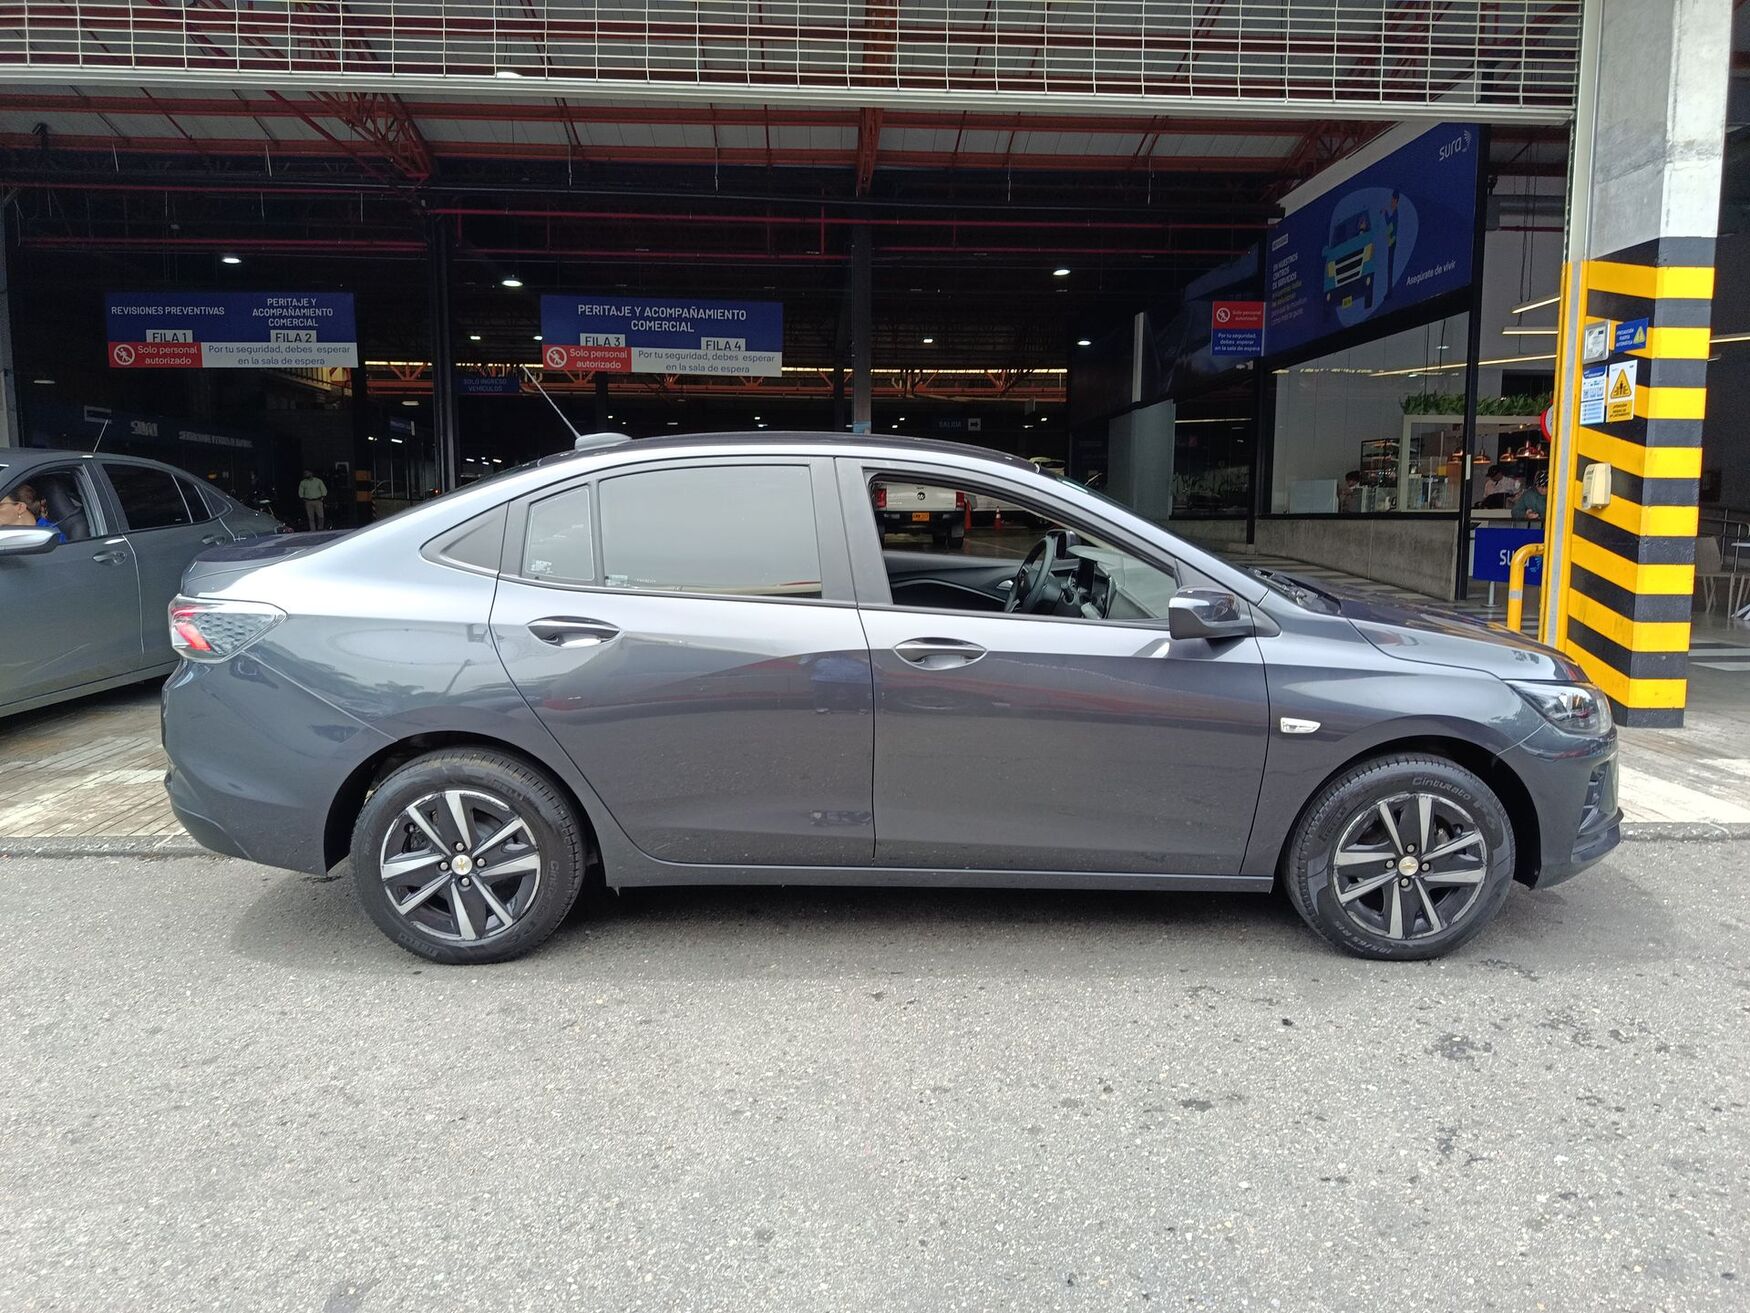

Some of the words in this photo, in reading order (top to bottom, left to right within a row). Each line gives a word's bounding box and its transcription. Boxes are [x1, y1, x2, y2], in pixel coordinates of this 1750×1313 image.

[1439, 136, 1462, 161] sura
[267, 298, 310, 307] PERITAJE
[310, 298, 317, 306] Y
[111, 306, 164, 315] REVISIONES
[165, 306, 225, 315] PREVENTIVAS
[252, 306, 333, 317] ACOMPAÑAMIENTO
[578, 305, 632, 317] PERITAJE
[633, 306, 641, 317] Y
[644, 306, 747, 321] ACOMPAÑAMIENTO
[268, 318, 318, 327] COMERCIAL
[631, 320, 695, 333] COMERCIAL
[152, 332, 179, 343] FILA
[182, 332, 187, 343] 1
[275, 332, 302, 343] FILA
[304, 332, 312, 343] 2
[585, 336, 612, 347] FILA
[613, 337, 621, 347] 3
[137, 345, 158, 354] Solo
[159, 345, 198, 356] personal
[209, 345, 224, 353] Por
[225, 345, 235, 353] tu
[285, 345, 313, 353] debes
[316, 346, 351, 355] esperar
[706, 340, 732, 351] FILA
[734, 341, 741, 352] 4
[145, 356, 192, 365] autorizado
[569, 349, 589, 358] Solo
[590, 349, 628, 361] personal
[638, 351, 654, 359] Por
[655, 351, 664, 360] tu
[665, 351, 711, 362] seguridad,
[712, 352, 739, 361] debes
[743, 354, 775, 364] esperar
[251, 356, 259, 365] la
[260, 356, 280, 365] sala
[282, 356, 293, 365] de
[294, 358, 325, 367] espera
[576, 360, 622, 369] autorizado
[679, 363, 687, 371] la
[688, 364, 706, 372] sala
[708, 364, 719, 372] de
[721, 366, 750, 375] espera
[1412, 777, 1472, 800] Cinturato
